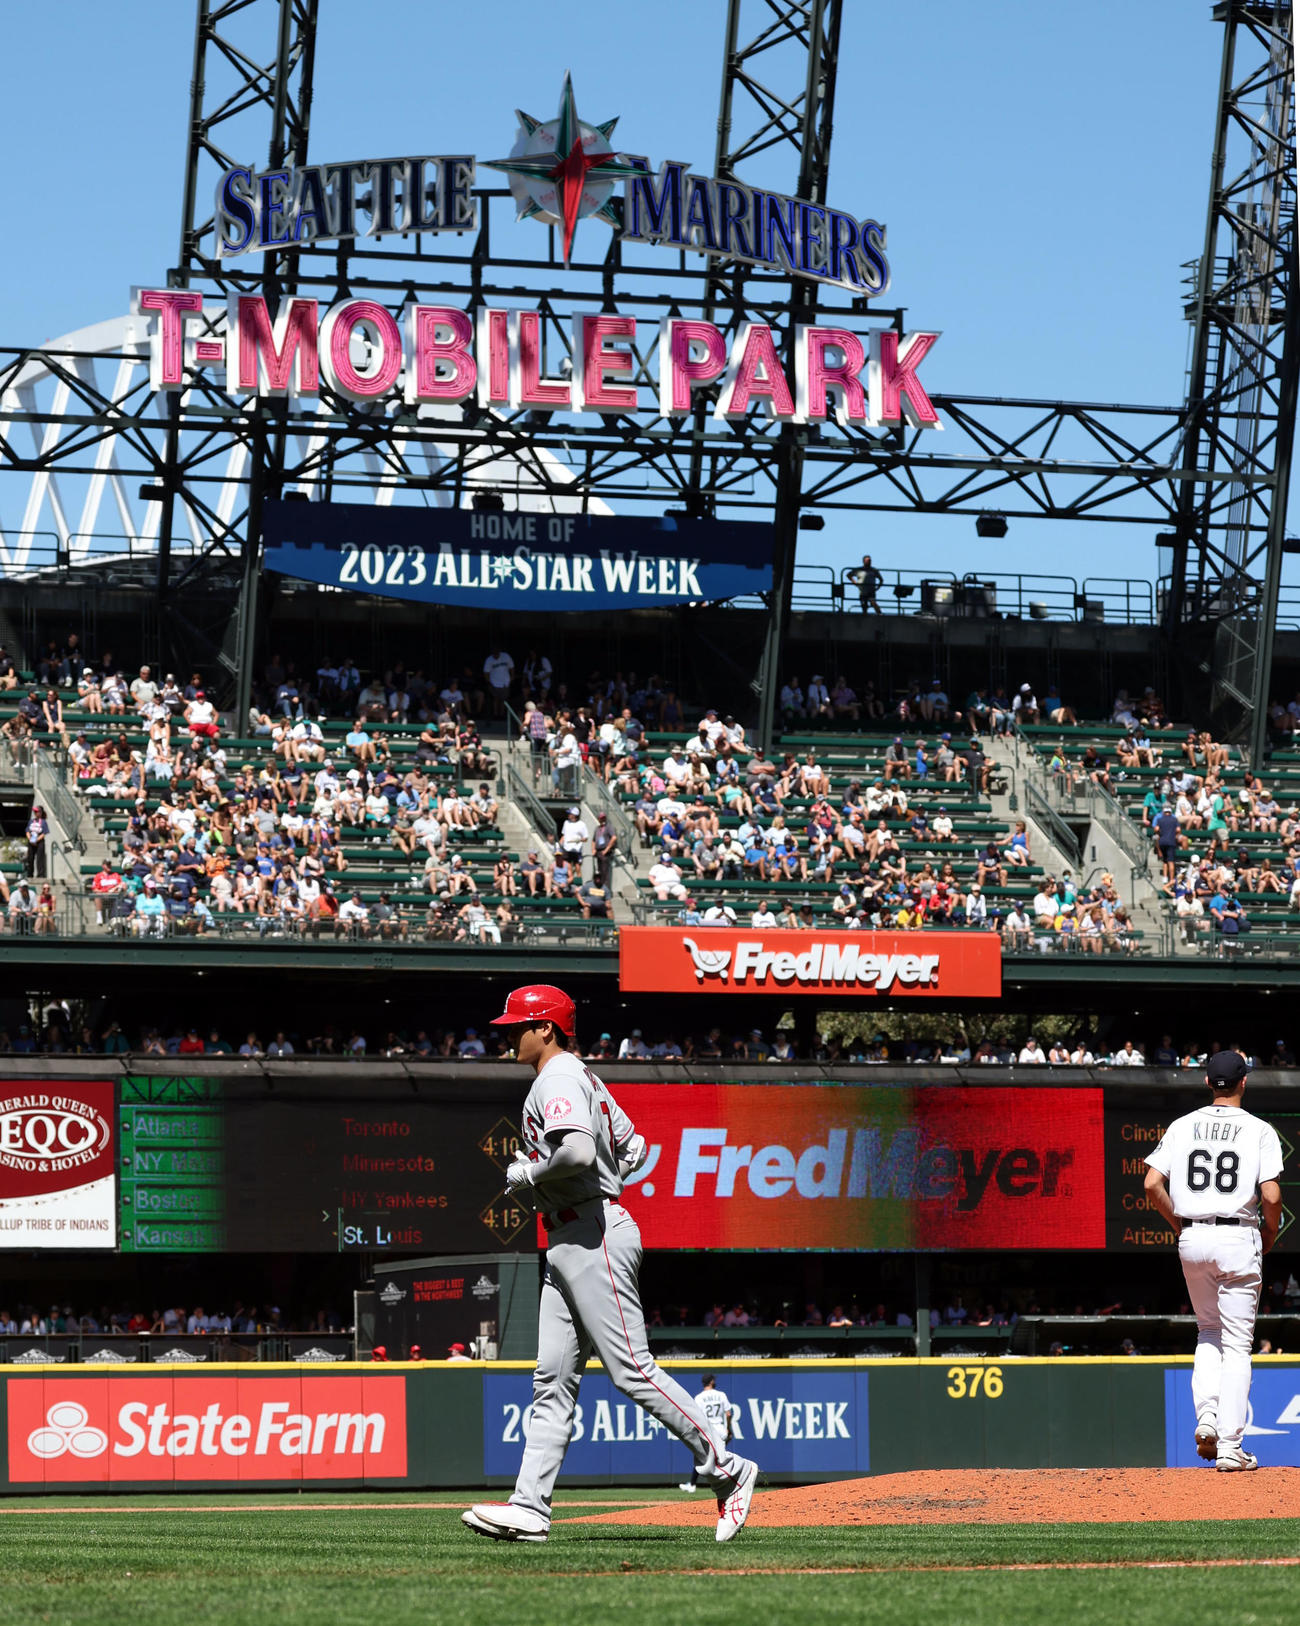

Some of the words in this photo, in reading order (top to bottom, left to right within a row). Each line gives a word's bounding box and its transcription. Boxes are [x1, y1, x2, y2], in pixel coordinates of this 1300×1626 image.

[216, 155, 477, 258] SEATTLE
[620, 154, 890, 297] MARINERS
[131, 285, 637, 414] T-MOBILE
[660, 315, 944, 430] PARK
[471, 514, 536, 541] HOME
[548, 518, 575, 542] OF
[339, 542, 427, 585] 2023
[600, 549, 703, 596] WEEK
[52, 1096, 98, 1120] QUEEN
[1, 1114, 89, 1157] EQC
[135, 1116, 200, 1137] Atlanta
[342, 1117, 410, 1137] Toronto
[1194, 1122, 1242, 1143] KIRBY
[483, 1136, 519, 1157] 4:10
[0, 1152, 36, 1172] SINO
[38, 1161, 49, 1172] &
[51, 1148, 100, 1172] HOTEL
[135, 1151, 163, 1171] NY
[343, 1153, 434, 1173] Minnesota
[1187, 1149, 1241, 1195] 68
[136, 1189, 200, 1210] Boston
[374, 1191, 448, 1209] Yankees
[26, 1218, 52, 1231] TRIBE
[55, 1218, 66, 1231] OF
[70, 1218, 110, 1231] INDIANS
[483, 1208, 521, 1229] 4:15
[343, 1225, 369, 1245] St.
[376, 1225, 423, 1245] Louis
[1122, 1227, 1178, 1246] Arizon
[947, 1366, 1004, 1399] 376
[705, 1403, 721, 1418] 27
[747, 1398, 851, 1440] WEEK
[502, 1404, 585, 1442] 23
